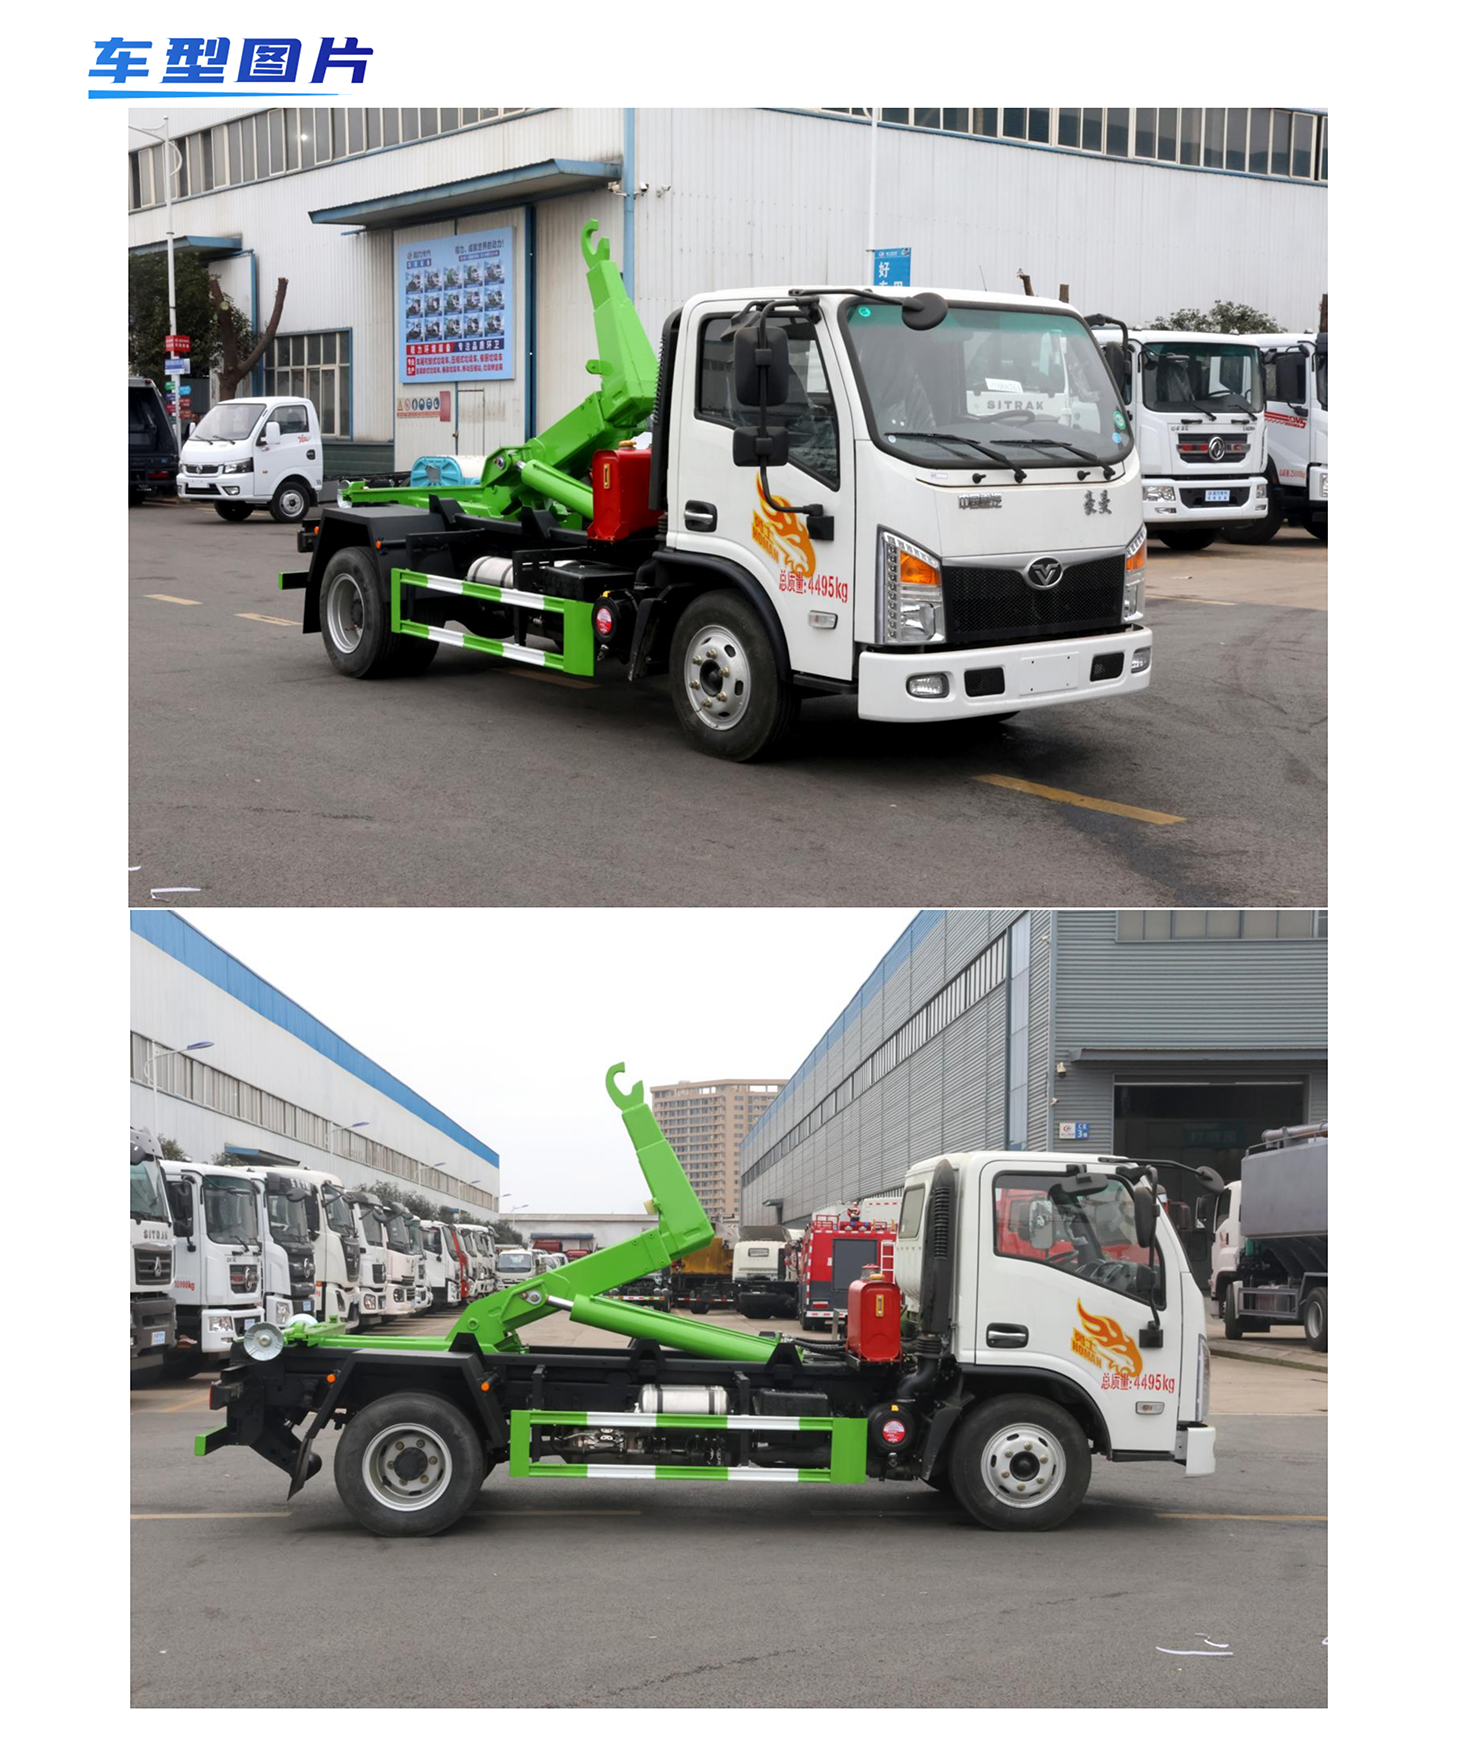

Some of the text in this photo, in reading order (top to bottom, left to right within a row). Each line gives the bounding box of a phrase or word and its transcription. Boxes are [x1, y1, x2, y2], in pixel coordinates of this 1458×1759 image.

[987, 400, 1043, 410] SITRAK
[779, 570, 848, 602] 总质量:4495kg
[1101, 1373, 1175, 1393] 总质量:4495kg
